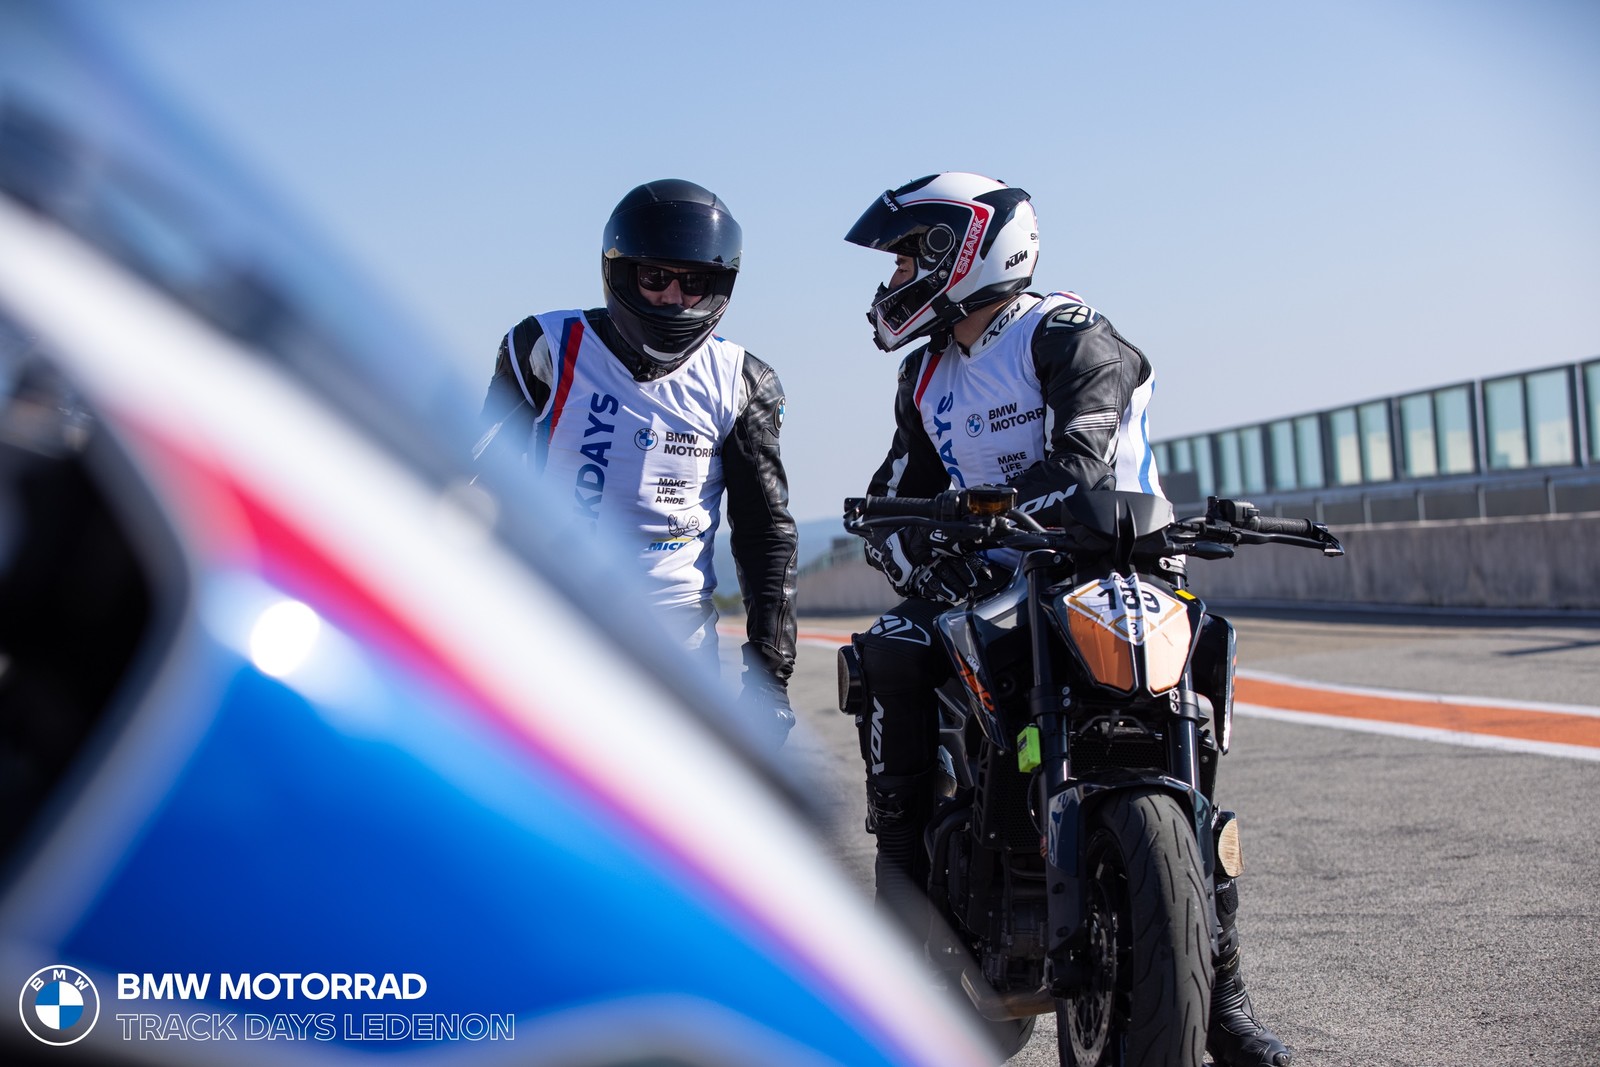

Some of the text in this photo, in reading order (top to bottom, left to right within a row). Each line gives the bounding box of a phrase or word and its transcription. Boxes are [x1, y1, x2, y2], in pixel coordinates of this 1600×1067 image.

[956, 215, 985, 275] SHARK
[1005, 250, 1028, 270] KTM
[988, 402, 1018, 420] BMW
[665, 431, 699, 445] BMW
[997, 451, 1027, 465] MAKE
[1001, 463, 1023, 474] LIFE
[658, 478, 687, 487] MAKE
[656, 486, 676, 495] LIFE
[655, 495, 685, 505] A RIDE
[1130, 622, 1139, 636] 3
